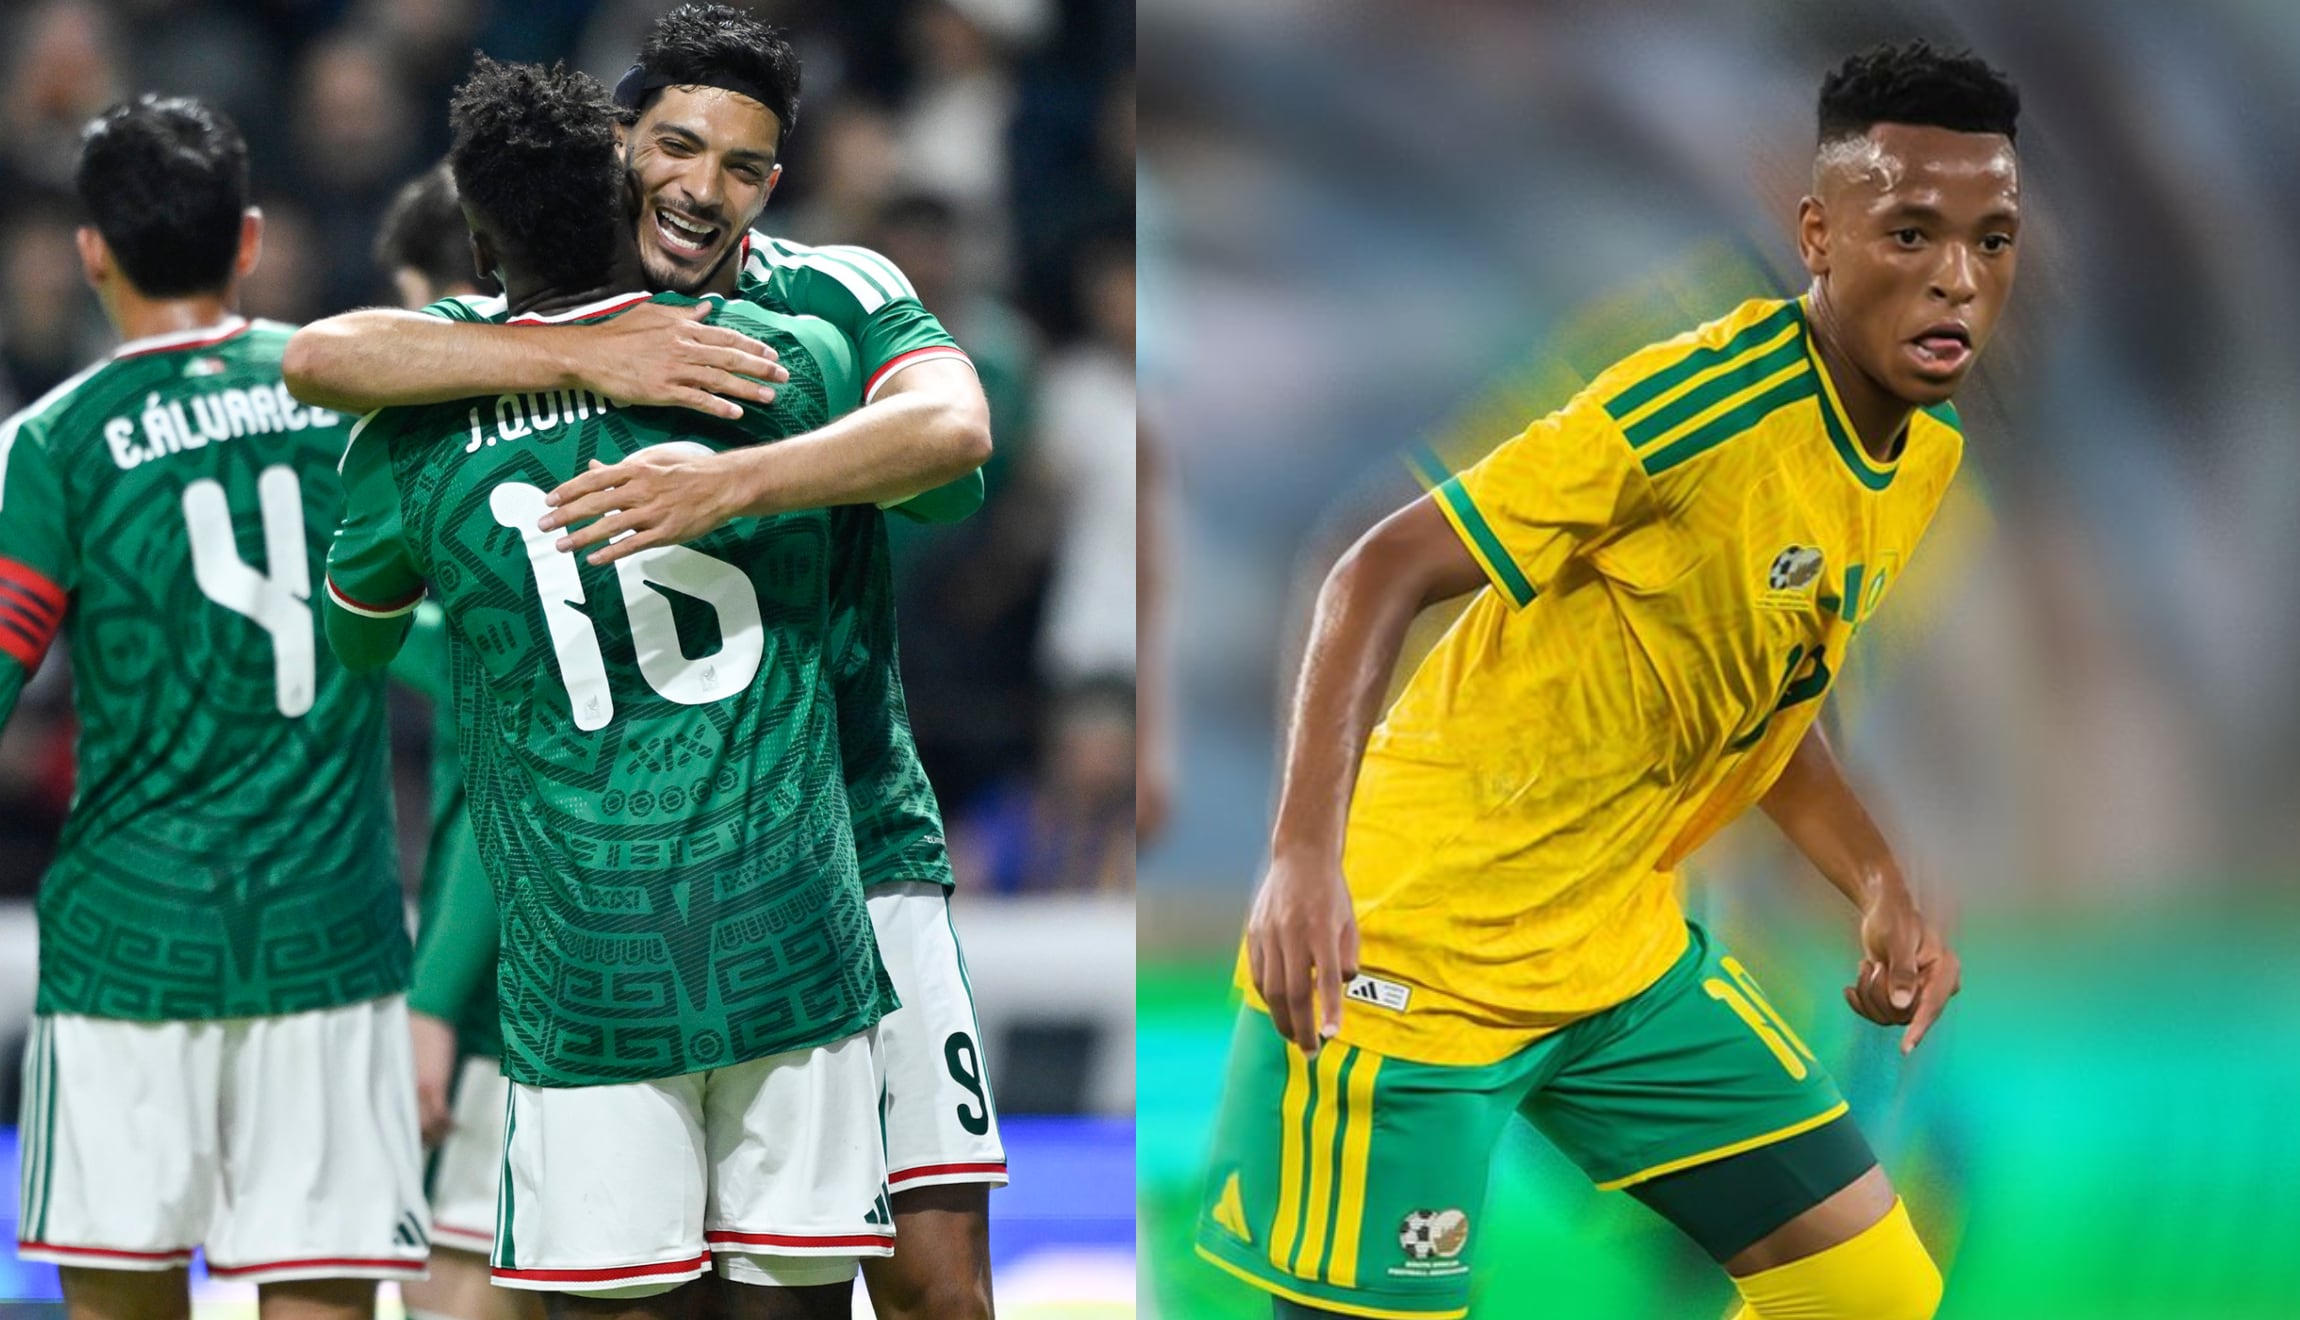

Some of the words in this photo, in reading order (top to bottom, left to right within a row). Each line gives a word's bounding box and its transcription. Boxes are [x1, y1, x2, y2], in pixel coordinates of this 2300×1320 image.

[465, 389, 630, 454] J.QUI
[182, 464, 316, 718] 4
[489, 440, 765, 732] 16
[944, 1031, 989, 1136] 9
